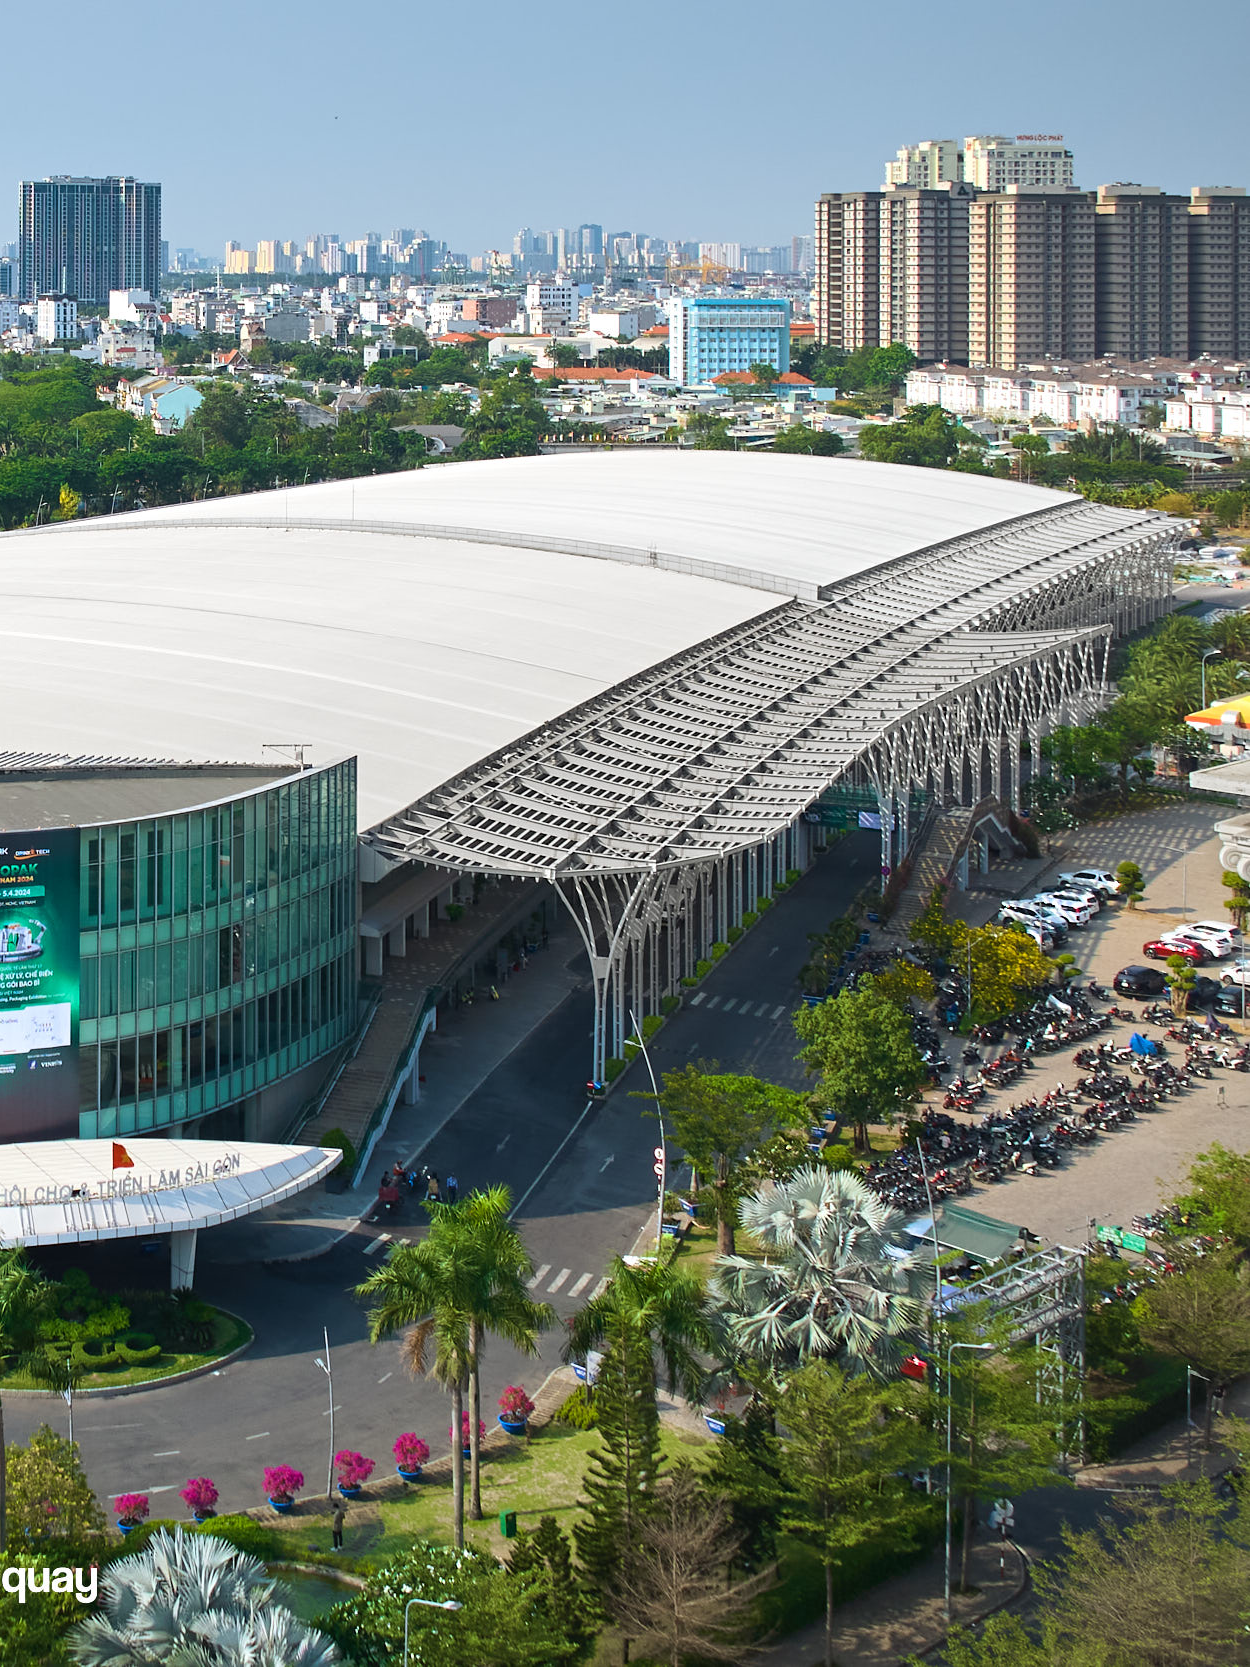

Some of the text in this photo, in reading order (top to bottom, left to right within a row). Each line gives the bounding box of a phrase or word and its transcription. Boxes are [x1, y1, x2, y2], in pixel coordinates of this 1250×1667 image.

[17, 875, 34, 883] 2024
[2, 889, 31, 897] 5.4.2024
[25, 969, 38, 978] CHẾ
[6, 980, 18, 989] GÓI
[19, 980, 33, 988] BAO
[149, 1168, 180, 1188] LÃM
[185, 1160, 208, 1183] SÀI
[213, 1152, 240, 1175] GÒN
